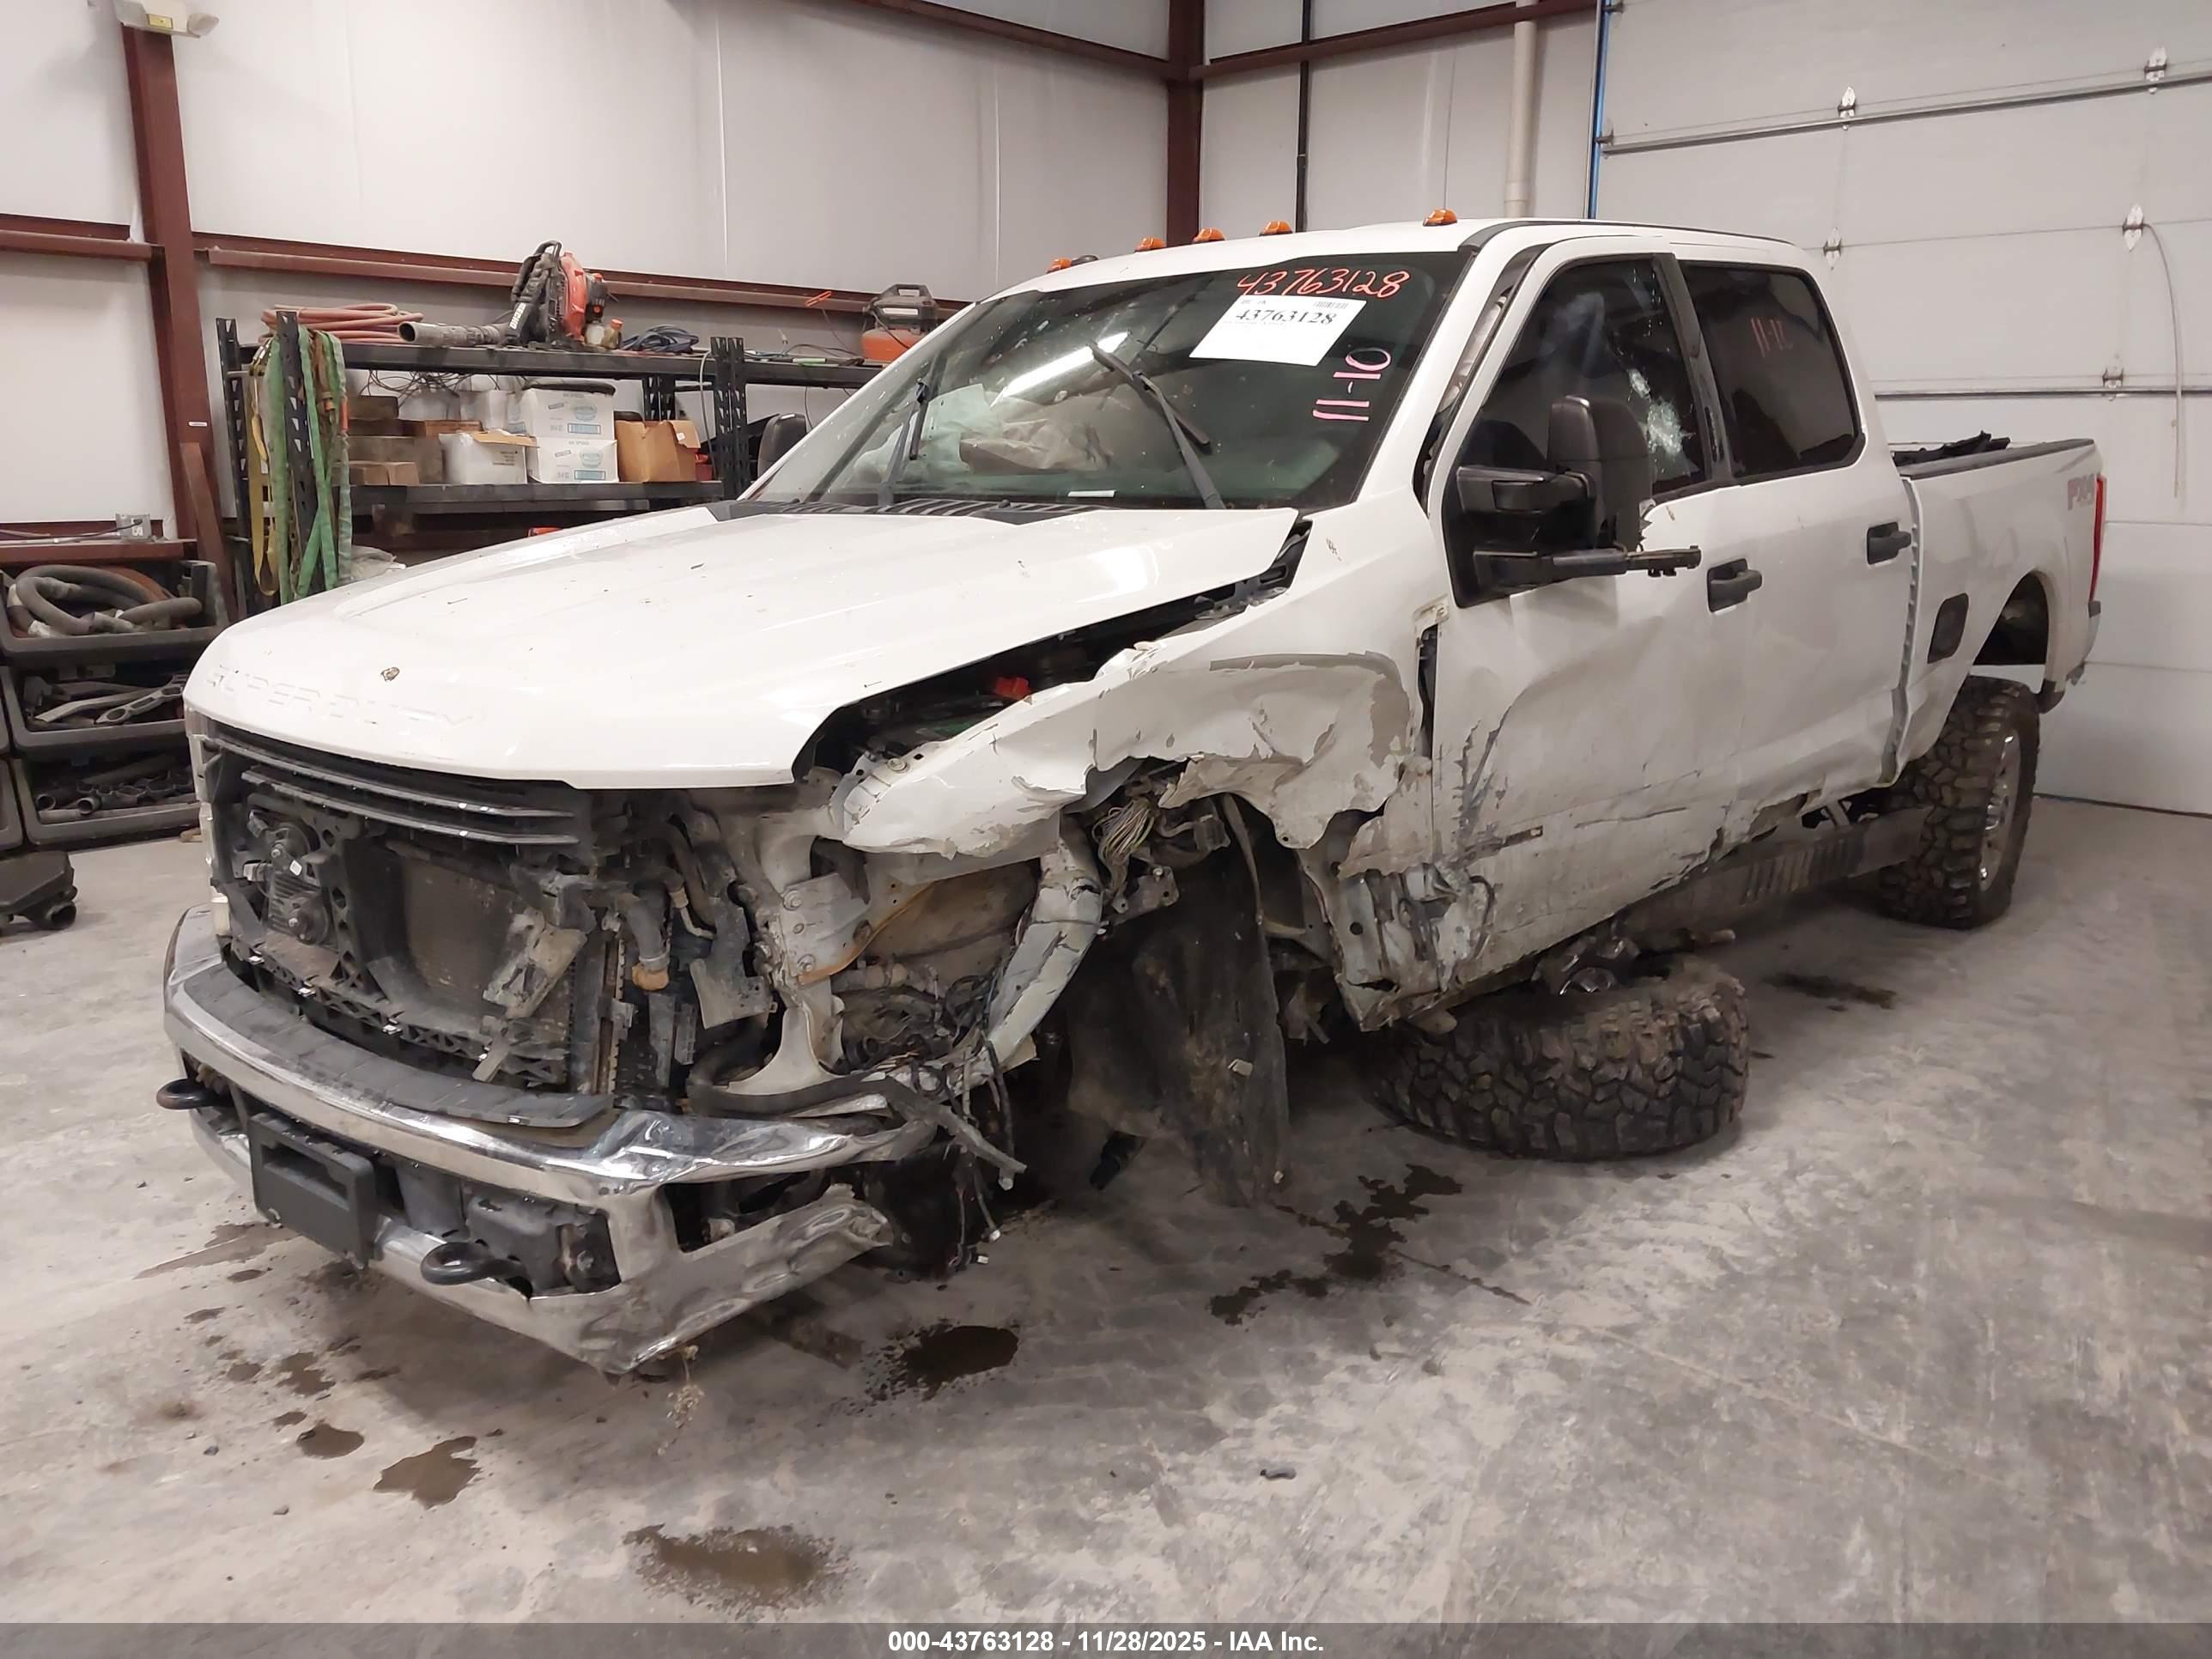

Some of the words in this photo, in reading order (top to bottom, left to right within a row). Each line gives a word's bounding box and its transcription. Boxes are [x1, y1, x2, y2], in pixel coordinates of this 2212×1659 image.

[1237, 268, 1410, 298] 43763128
[1236, 309, 1337, 325] 43763128
[1313, 348, 1391, 422] 11-10
